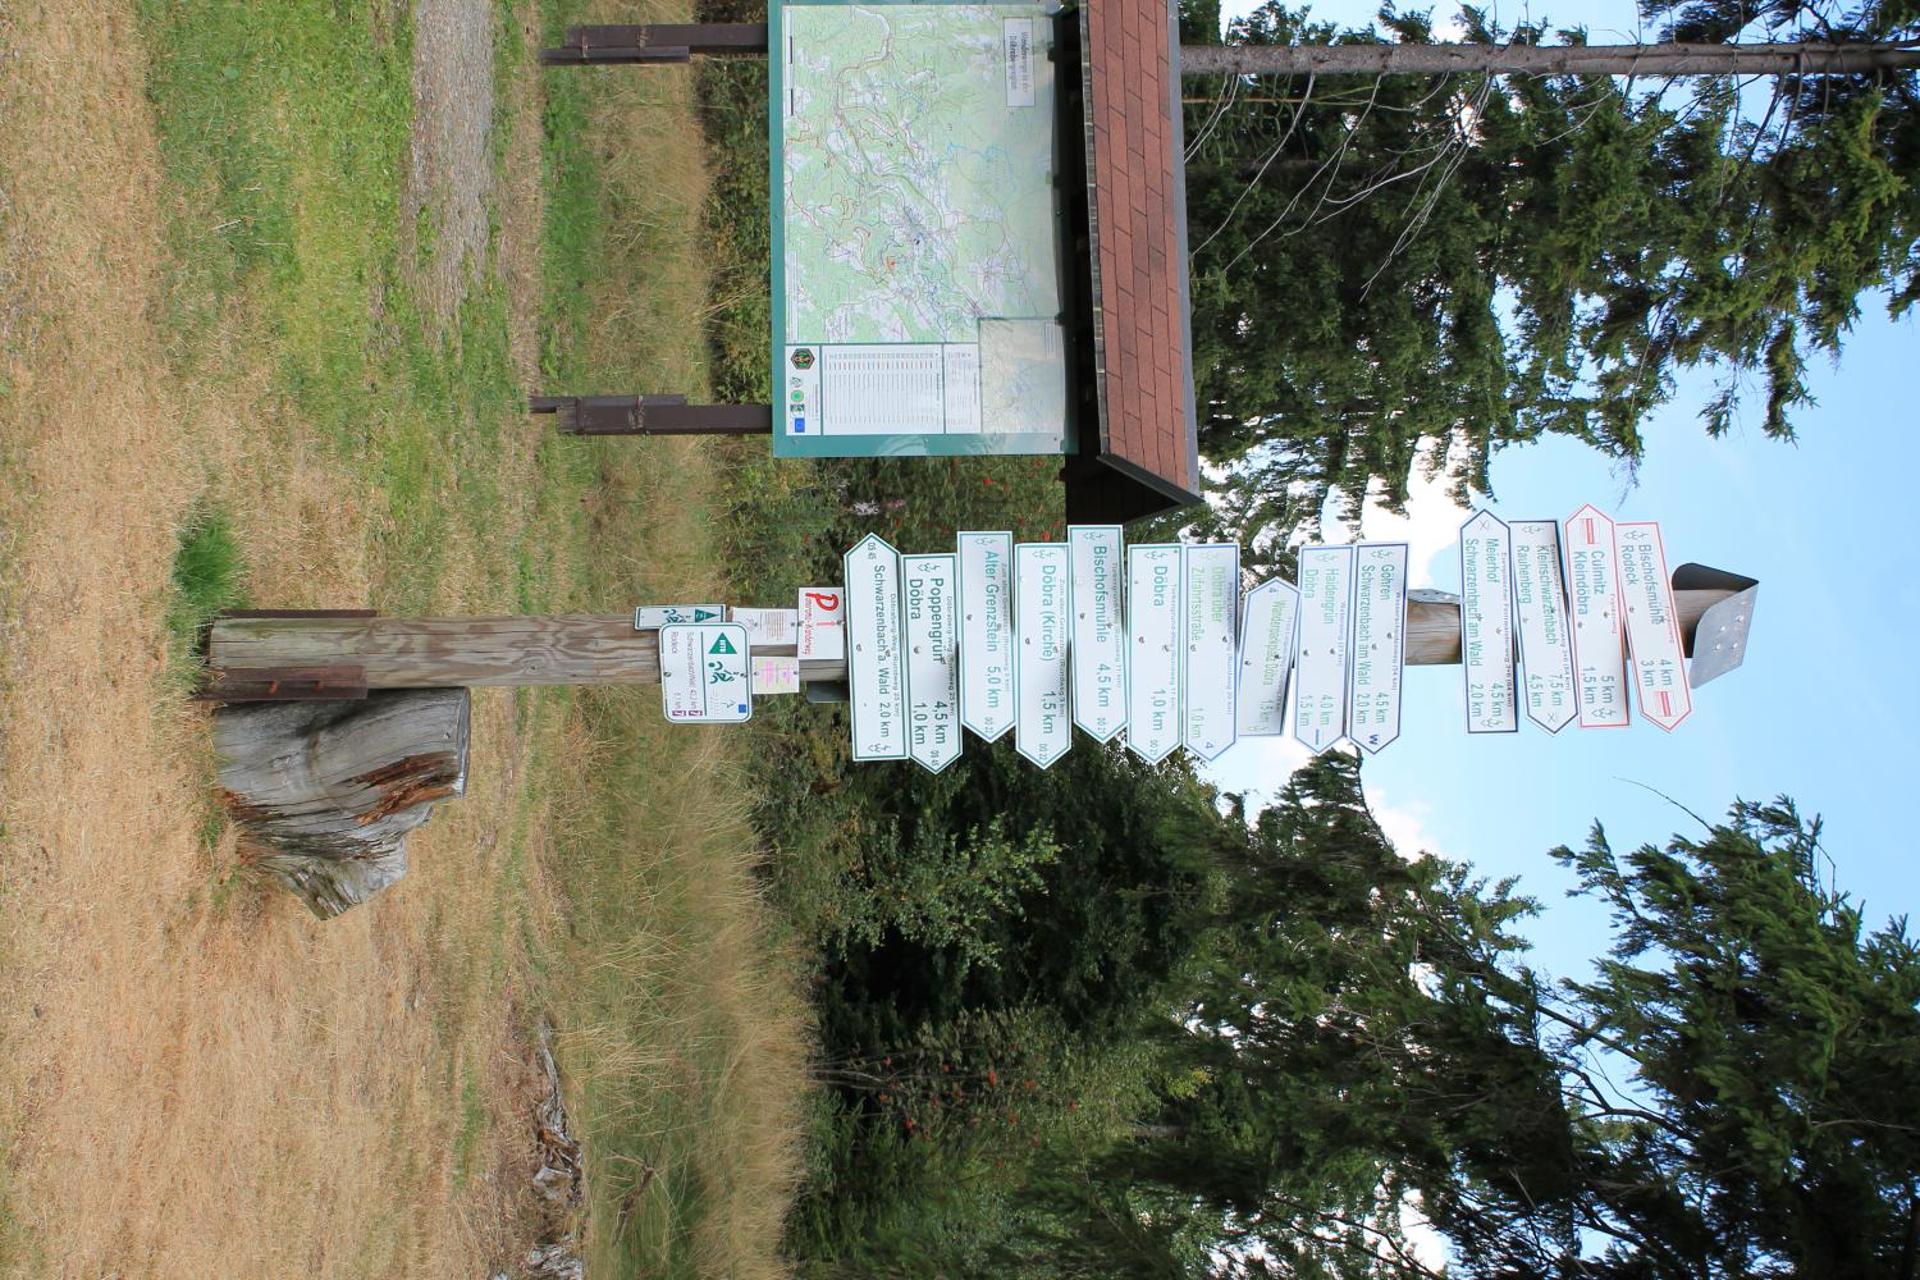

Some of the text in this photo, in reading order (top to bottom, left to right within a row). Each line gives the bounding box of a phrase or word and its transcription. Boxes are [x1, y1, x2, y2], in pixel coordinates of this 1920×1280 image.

[874, 565, 888, 651] Schwarzenbach
[985, 551, 1001, 707] Alter Grenzstein 5,0 km
[1041, 565, 1056, 734] Döbra (Kirche) 1,5 km
[1094, 546, 1112, 707] Bischofsmühle 4,5 km
[1151, 566, 1168, 730] Döbra 1,0 km
[1211, 567, 1225, 624] Döbra über
[1304, 569, 1318, 598] Döbra
[1319, 568, 1339, 725] Haidengrün 4,0 km
[1356, 565, 1376, 724] Schwarzenbach am Wald 2,0 km
[1374, 564, 1395, 723] Göhren 4,5 km
[1465, 539, 1484, 717] Schwarzenbach am Wald 2,0 km
[1486, 538, 1504, 716] Meierhof 4,5 km
[1516, 545, 1544, 707] Rauhenberg 4,5 km
[1537, 545, 1564, 705] Kleinschwarzenbach 7,5 km
[1573, 551, 1589, 615] Kleindöbra
[1584, 685, 1597, 704] km
[1591, 551, 1605, 594] Culmitz
[1602, 685, 1615, 703] km
[1620, 545, 1638, 585] Rodeck
[1642, 670, 1655, 687] km
[1638, 544, 1662, 625] Bischofsmühle
[1660, 669, 1674, 686] km
[878, 668, 891, 694] Wald
[878, 702, 891, 719] 2,0
[880, 721, 890, 737] km
[910, 579, 926, 745] Döbra 1,0 km
[928, 578, 947, 744] Poppengrün 4,5 km
[1191, 724, 1203, 737] km
[1260, 712, 1273, 722] km
[1300, 713, 1314, 726] km
[1369, 734, 1378, 745] W
